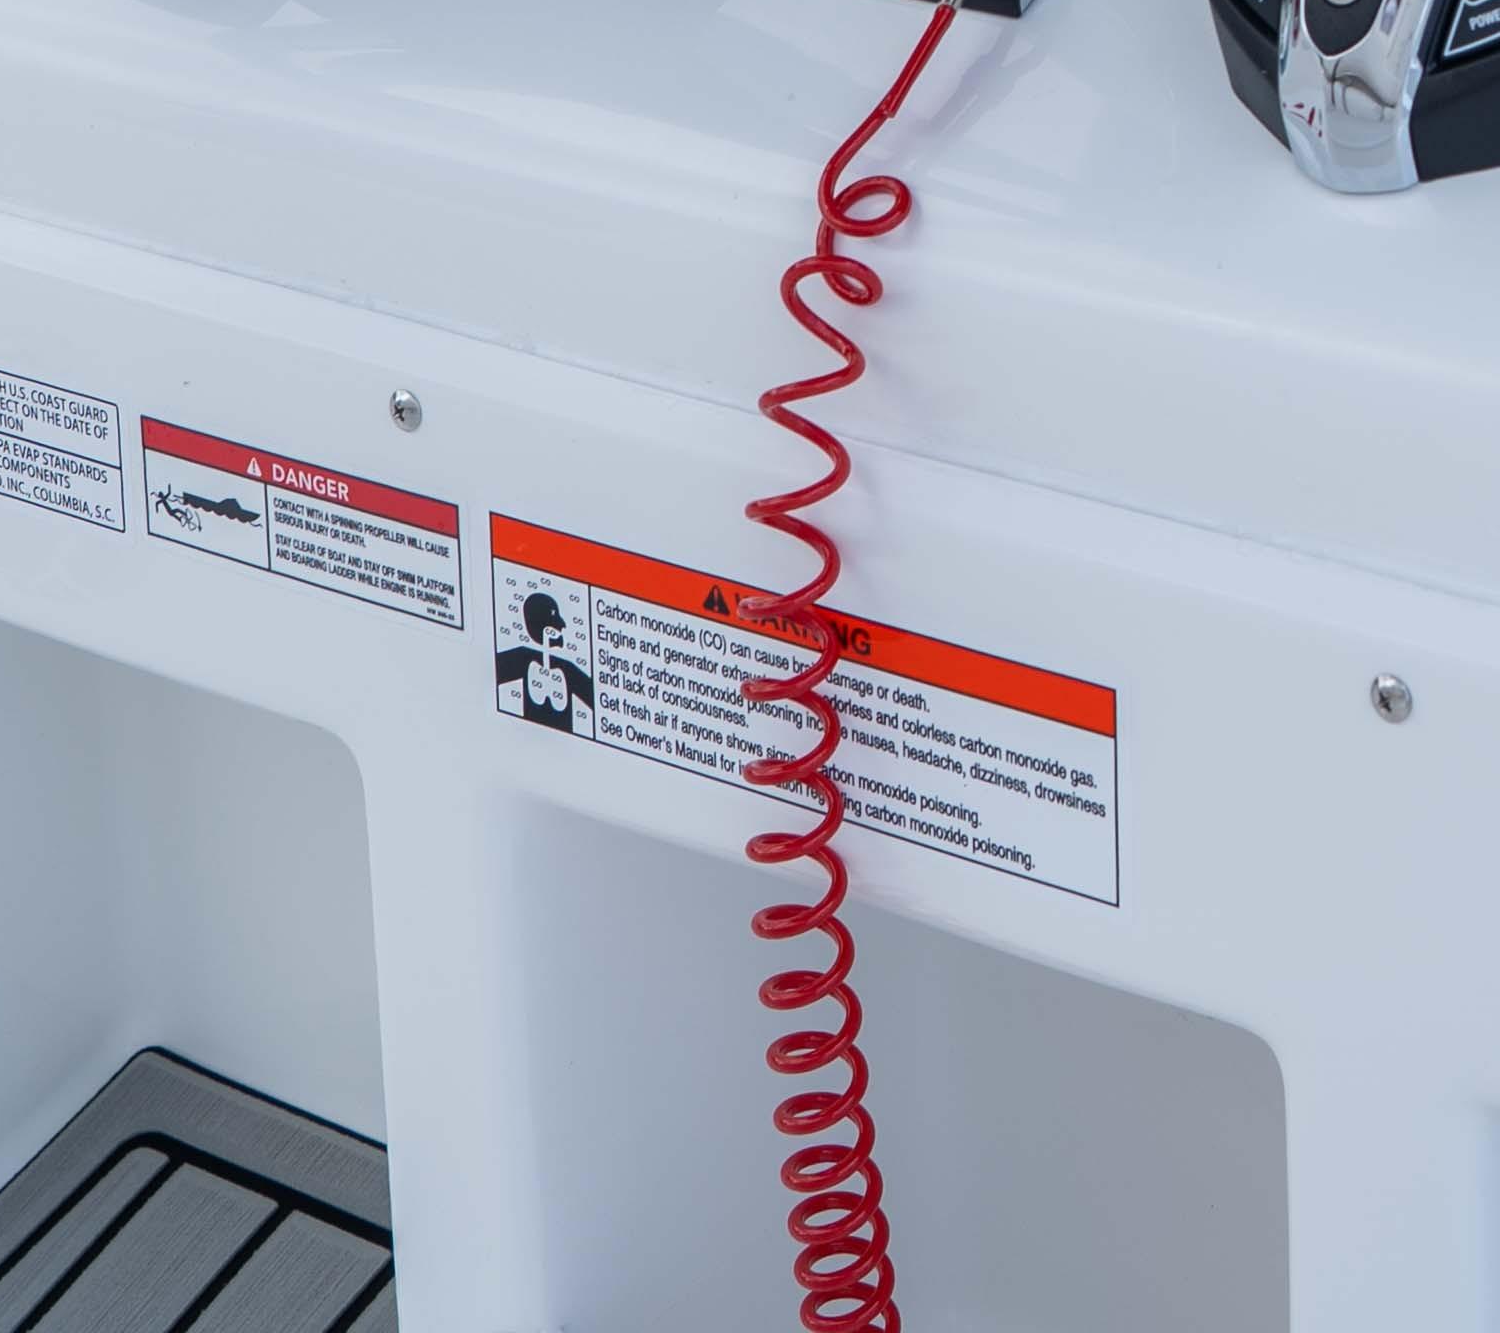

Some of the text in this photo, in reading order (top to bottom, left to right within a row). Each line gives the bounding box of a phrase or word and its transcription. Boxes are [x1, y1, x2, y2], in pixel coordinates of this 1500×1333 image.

[8, 382, 28, 401] U.S.
[30, 389, 65, 411] COAST
[68, 400, 108, 423] GUARD
[21, 403, 38, 420] ON
[39, 407, 61, 427] THE
[63, 415, 91, 435] DATE
[93, 424, 108, 439] OF
[12, 442, 39, 461] EVAP
[42, 451, 107, 483] STANDARDS
[271, 462, 349, 503] DANGER
[6, 476, 30, 498] INC.,
[32, 485, 92, 517] COLUMBIA,
[94, 504, 114, 522] S.C.
[596, 599, 929, 712] Carbon monoxide (CO) can cause or death.
[597, 623, 1096, 787] Engine and generator and colorless carbon monoxide gas.
[598, 670, 748, 727] and lack of consciousness.
[598, 649, 1105, 817] Signs of carbon monoxide poisoning nausea, headache, dizziness, drowsiness
[599, 692, 981, 827] Get fresh air anyone shows monoxide poisoning.
